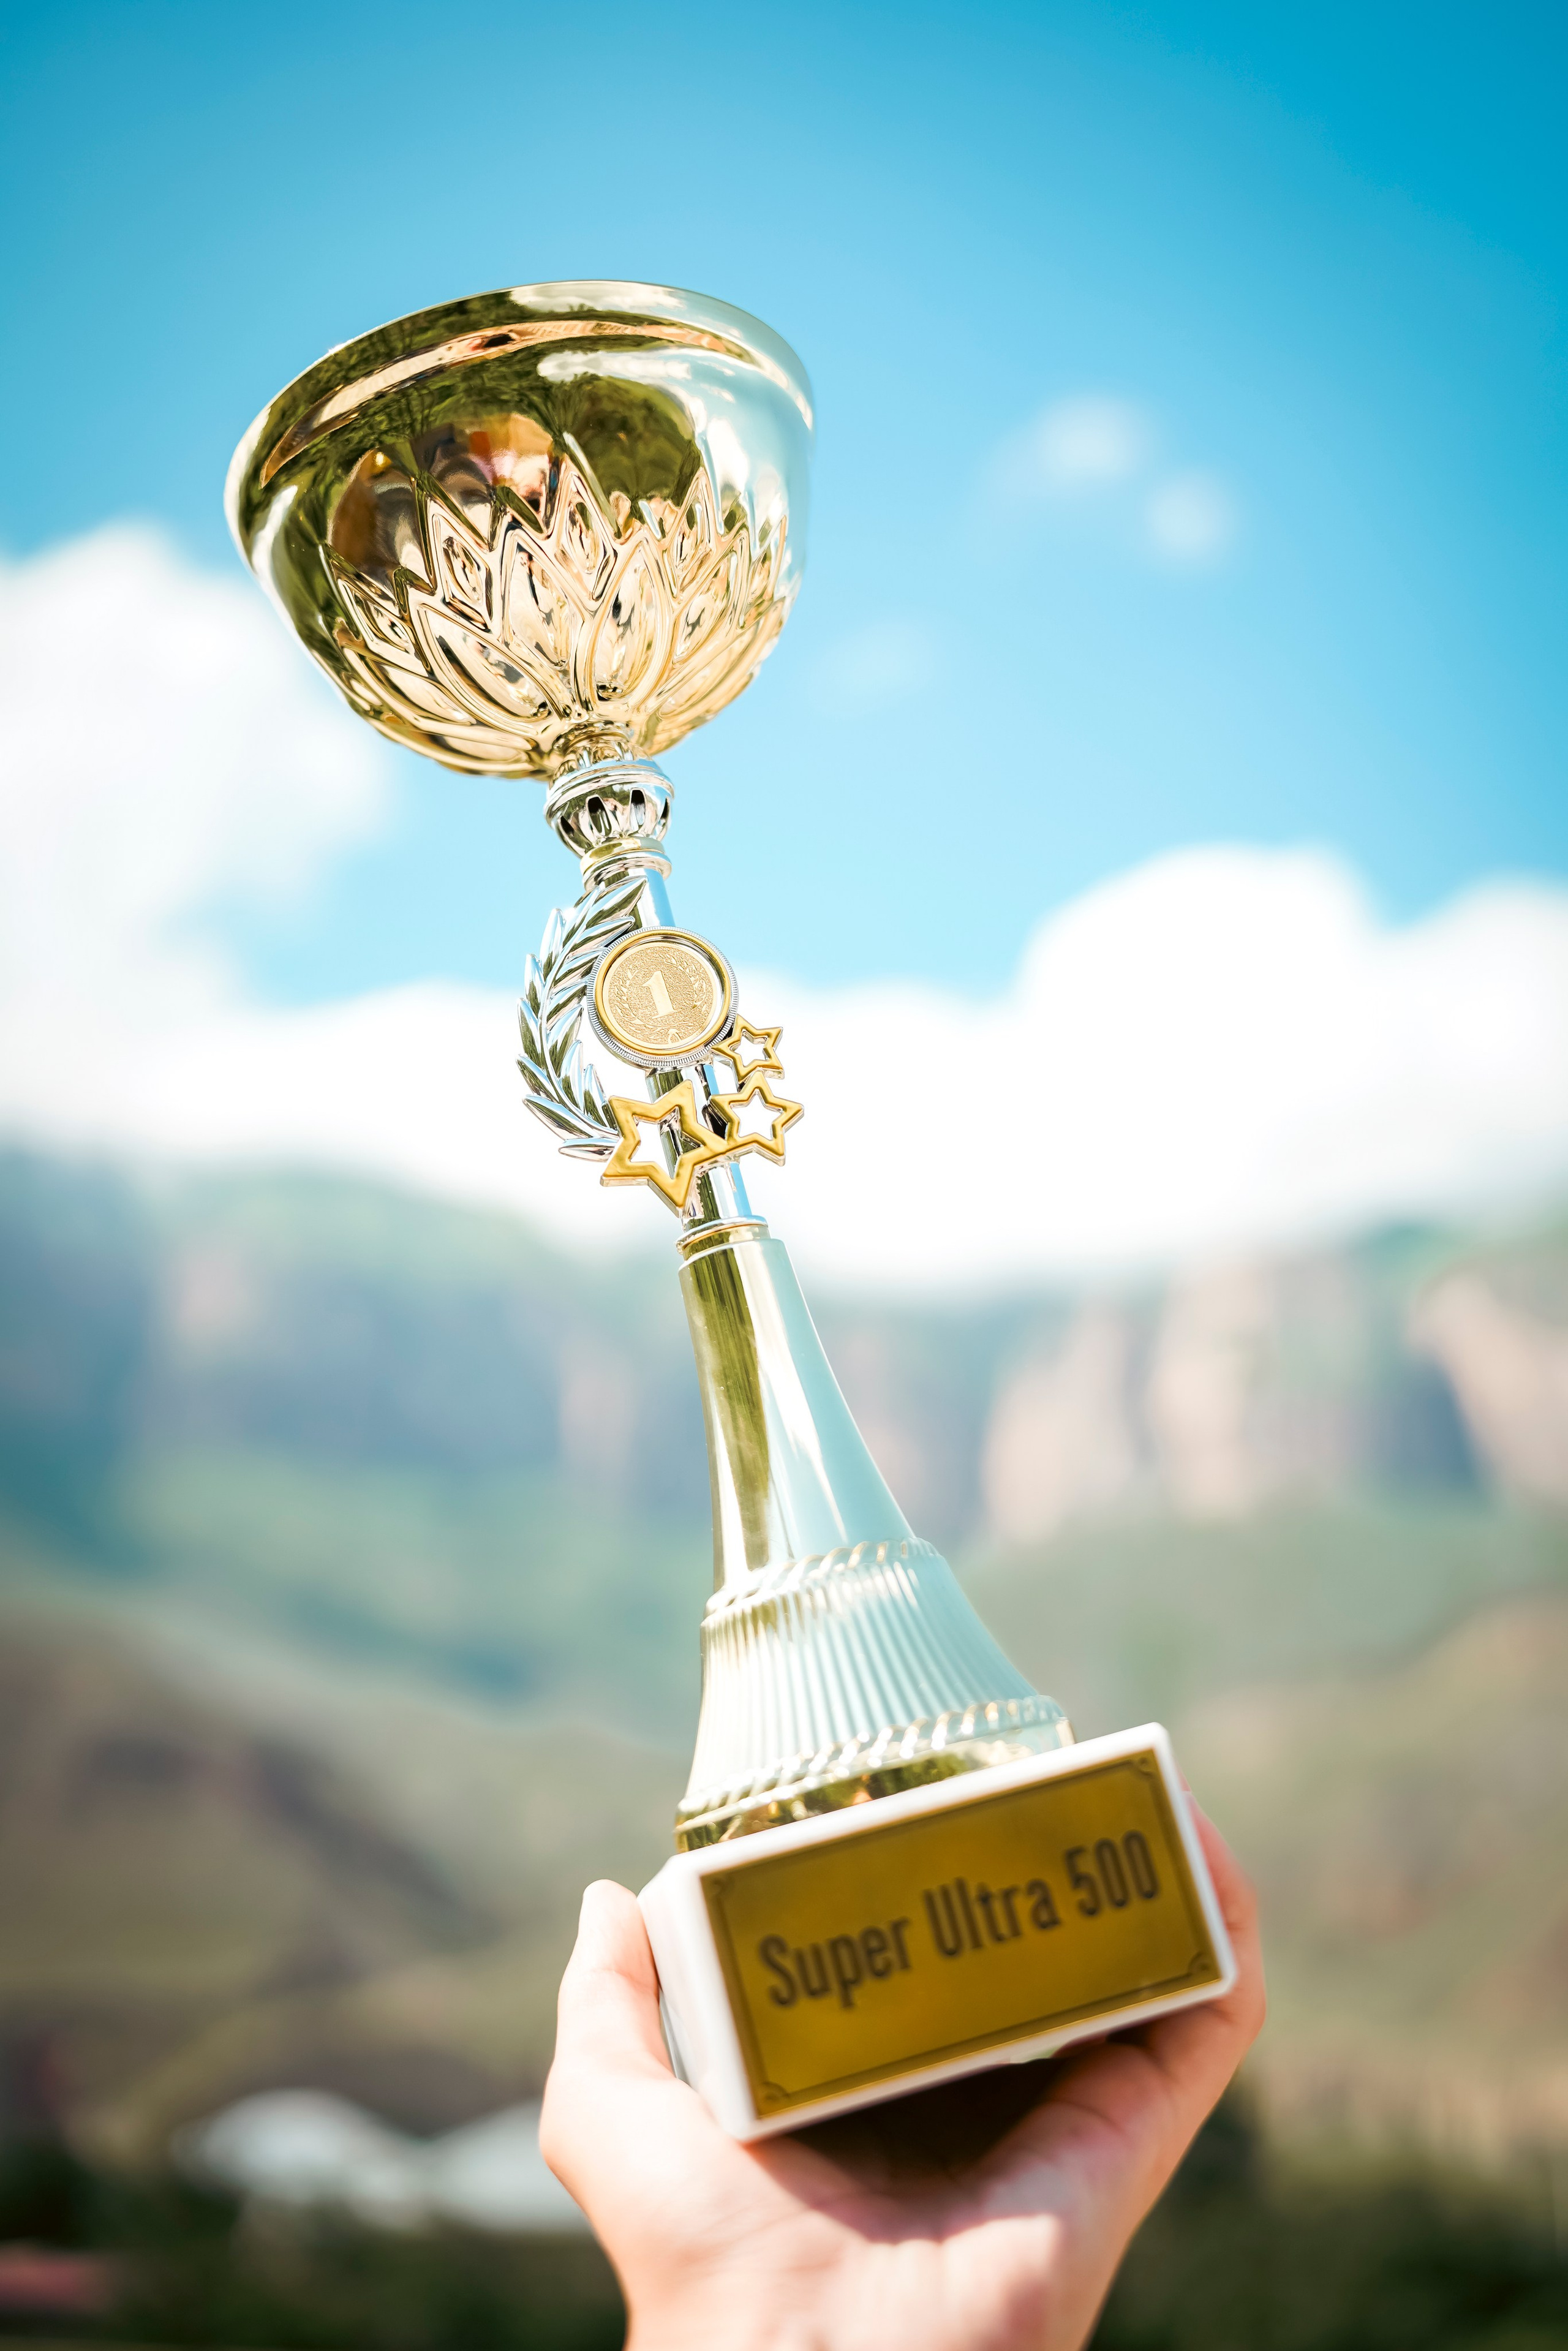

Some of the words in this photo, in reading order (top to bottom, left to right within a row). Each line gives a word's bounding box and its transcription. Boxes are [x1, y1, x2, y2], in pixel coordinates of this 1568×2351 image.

[643, 970, 684, 1019] 1
[758, 1915, 912, 2009] Super
[922, 1877, 1061, 1958] Ultra
[1063, 1830, 1160, 1917] 500
